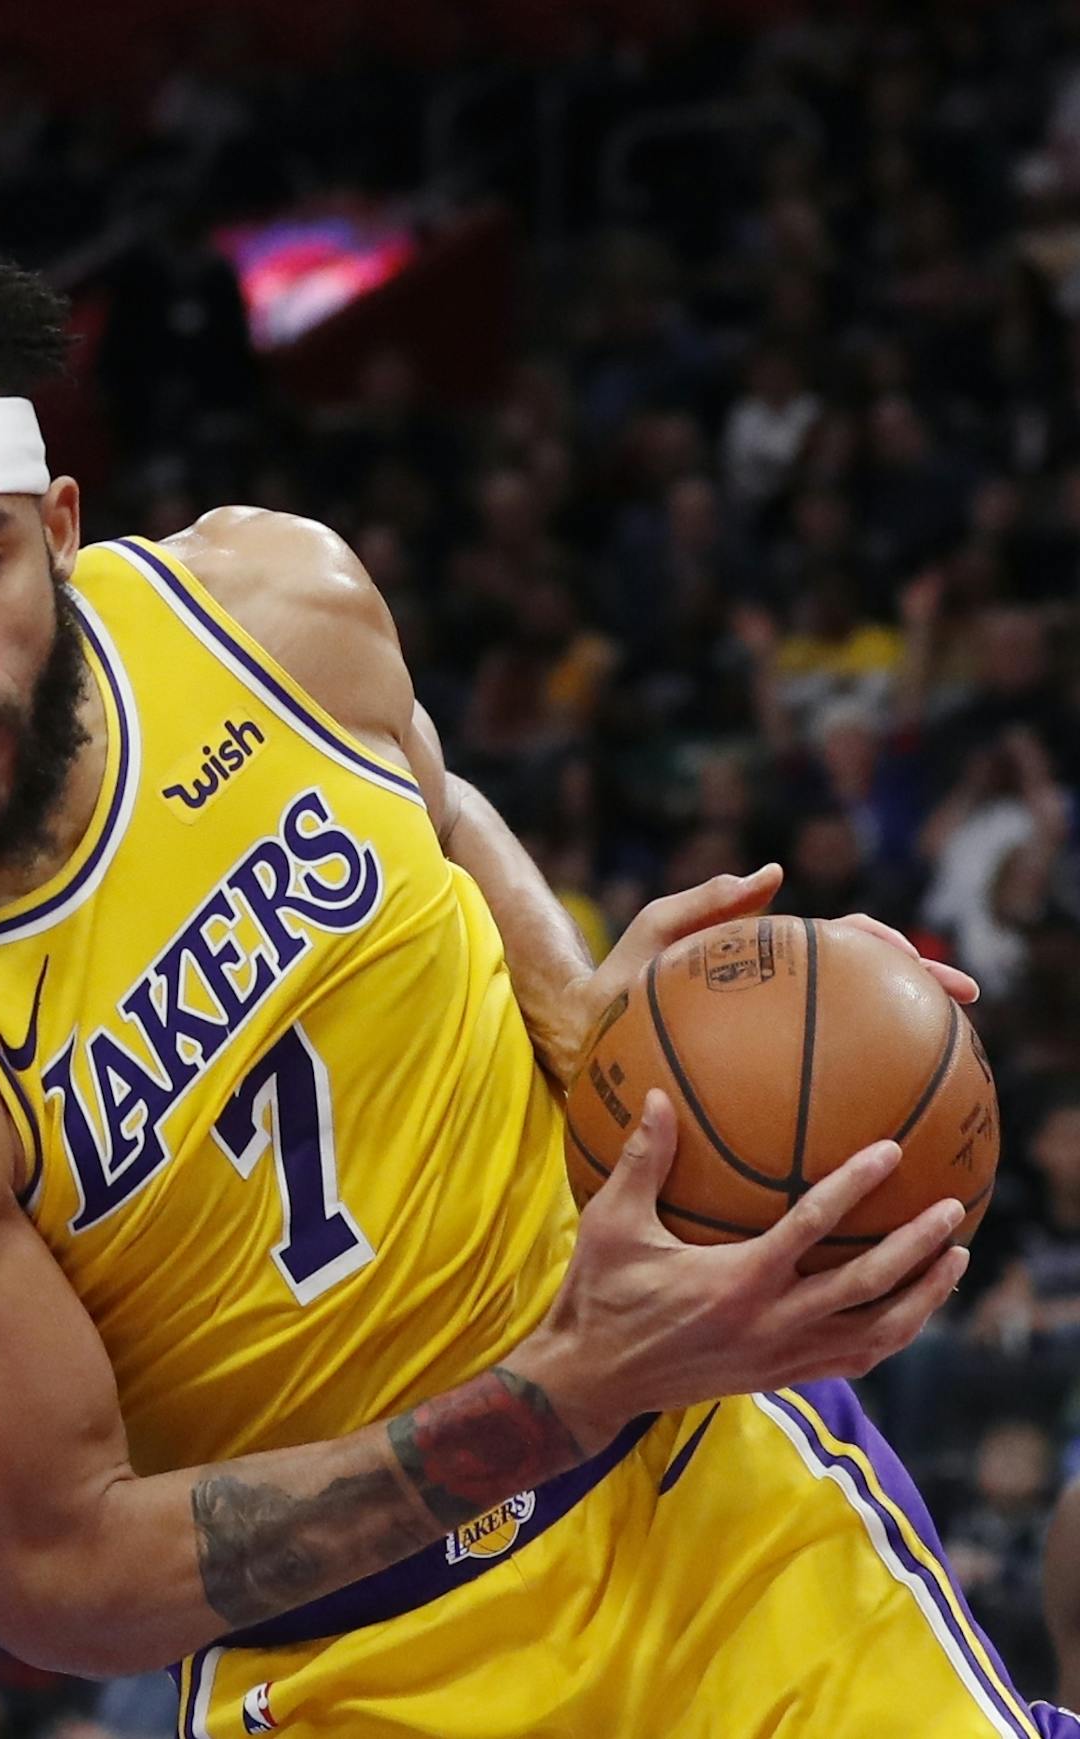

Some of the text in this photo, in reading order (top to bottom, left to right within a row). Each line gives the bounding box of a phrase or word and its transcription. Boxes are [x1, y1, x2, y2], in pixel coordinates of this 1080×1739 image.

[163, 717, 265, 810] wish
[41, 787, 383, 1234] LAKERS
[209, 1022, 376, 1306] 7
[445, 1490, 536, 1565] LAKERS
